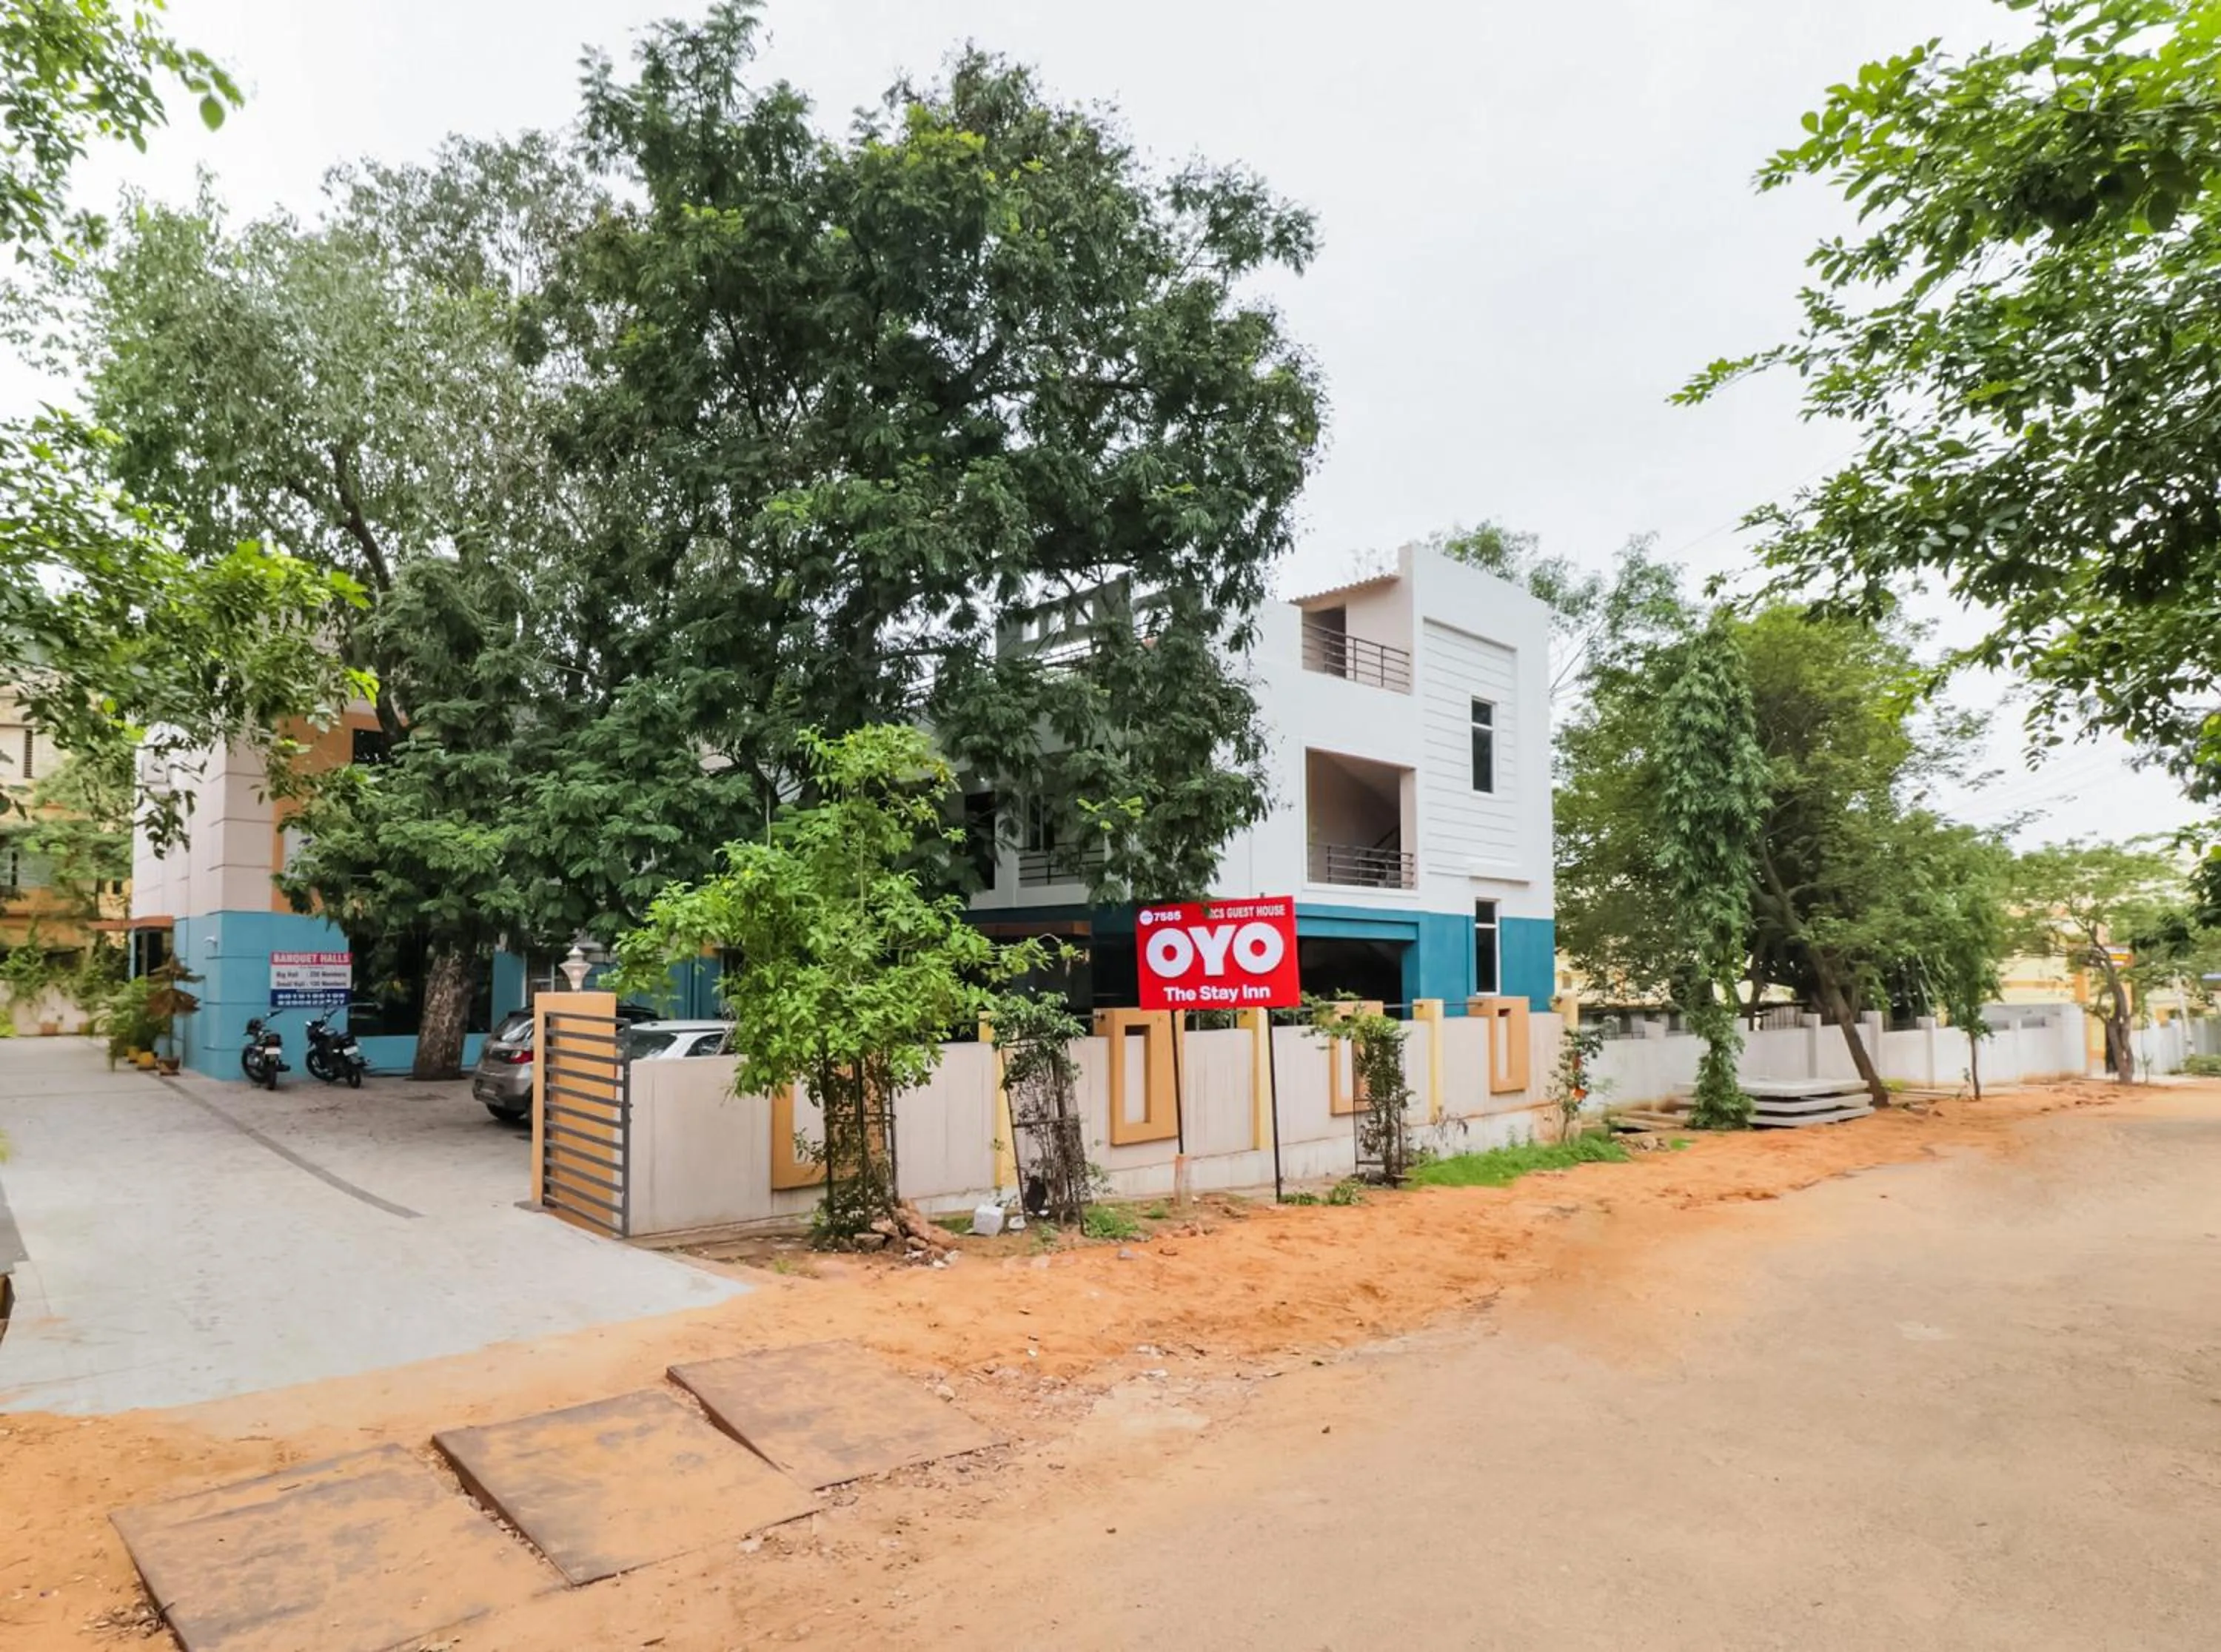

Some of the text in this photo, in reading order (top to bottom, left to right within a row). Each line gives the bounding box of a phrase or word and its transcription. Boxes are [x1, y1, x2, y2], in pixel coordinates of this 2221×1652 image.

[1226, 906, 1255, 919] GUEST
[1256, 904, 1286, 917] HOUSE
[1146, 921, 1284, 978] OYO
[273, 953, 350, 964] BANQUET HALLS
[1163, 984, 1271, 1003] The Stay Inn
